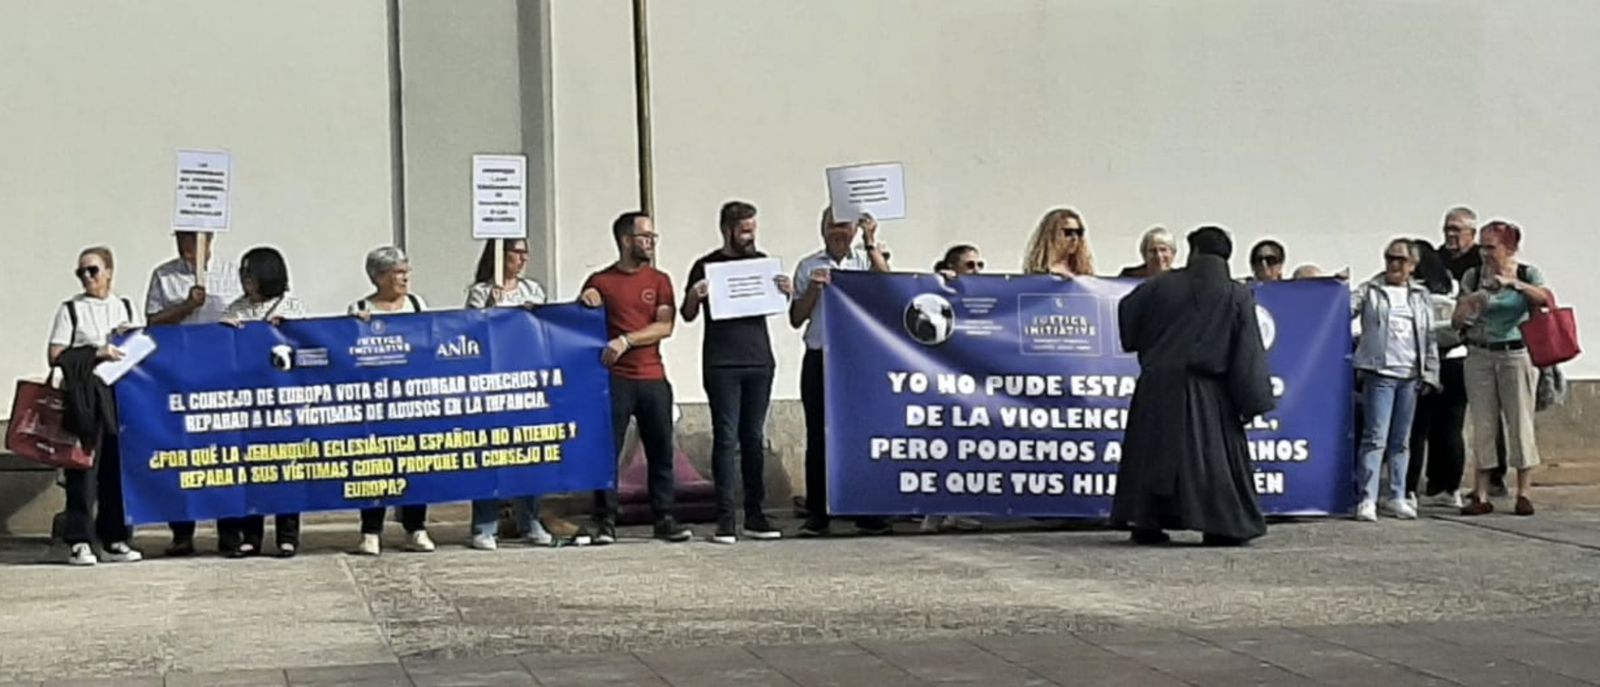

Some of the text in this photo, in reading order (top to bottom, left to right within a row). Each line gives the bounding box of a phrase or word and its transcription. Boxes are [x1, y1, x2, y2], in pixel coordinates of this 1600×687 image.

[169, 368, 563, 412] EL CONSEJO DE EUROPA VOTA SÍ A OTORGAR DERECHOS Y A
[887, 372, 1136, 397] YO NO PUDE ESTA
[185, 410, 249, 432] REPARAR
[252, 410, 263, 428] A
[266, 408, 292, 427] LAS
[296, 403, 362, 425] VÍCTIMAS
[366, 403, 384, 421] DE
[388, 399, 440, 419] ABUSOS
[444, 398, 462, 416] EN
[465, 396, 483, 414] LA
[906, 405, 1128, 429] DE LA VIOLENCI
[150, 421, 577, 469] ¿POR QUÉ LA JERARQUÍA ECLESIÁSTICA ESPAÑOLA NO ATIENDE Y
[870, 438, 948, 460] PERO
[957, 439, 1095, 462] PODEMOS
[180, 444, 560, 489] REPARA A SUS VÍCTIMAS COMO PROPONE EL CONSEJO DE
[344, 478, 407, 498] EUROPA?
[900, 471, 1118, 495] DE QUE TUS HIJ
